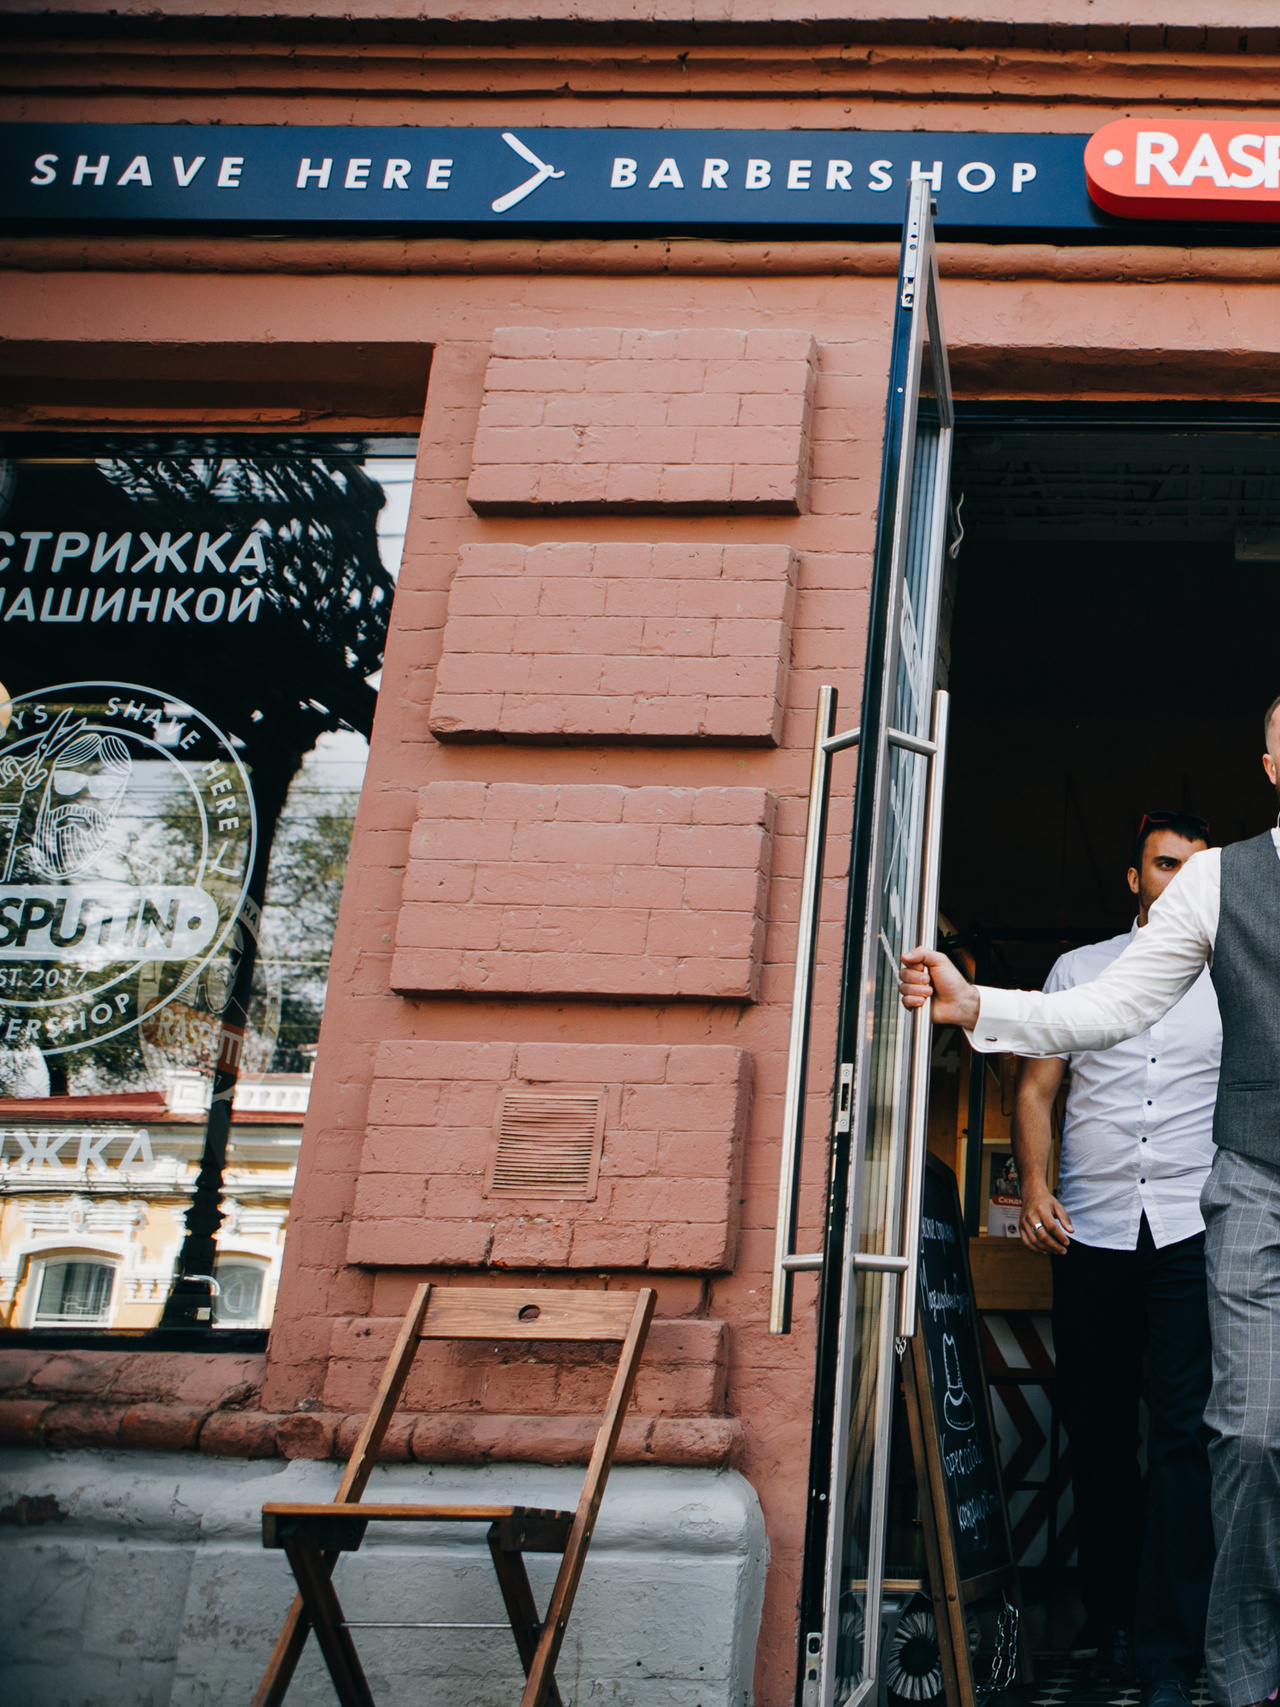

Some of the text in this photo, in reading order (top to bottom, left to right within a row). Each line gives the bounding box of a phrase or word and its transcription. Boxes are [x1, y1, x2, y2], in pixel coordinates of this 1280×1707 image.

[30, 154, 454, 190] SHAVE HERE
[609, 156, 1037, 194] BARBERSHOP
[0, 578, 262, 622] АШИНКОЙ
[104, 697, 201, 751] SHAVE
[201, 758, 240, 833] HERE
[30, 967, 87, 987] 2017
[0, 1128, 155, 1173] ЖКА
